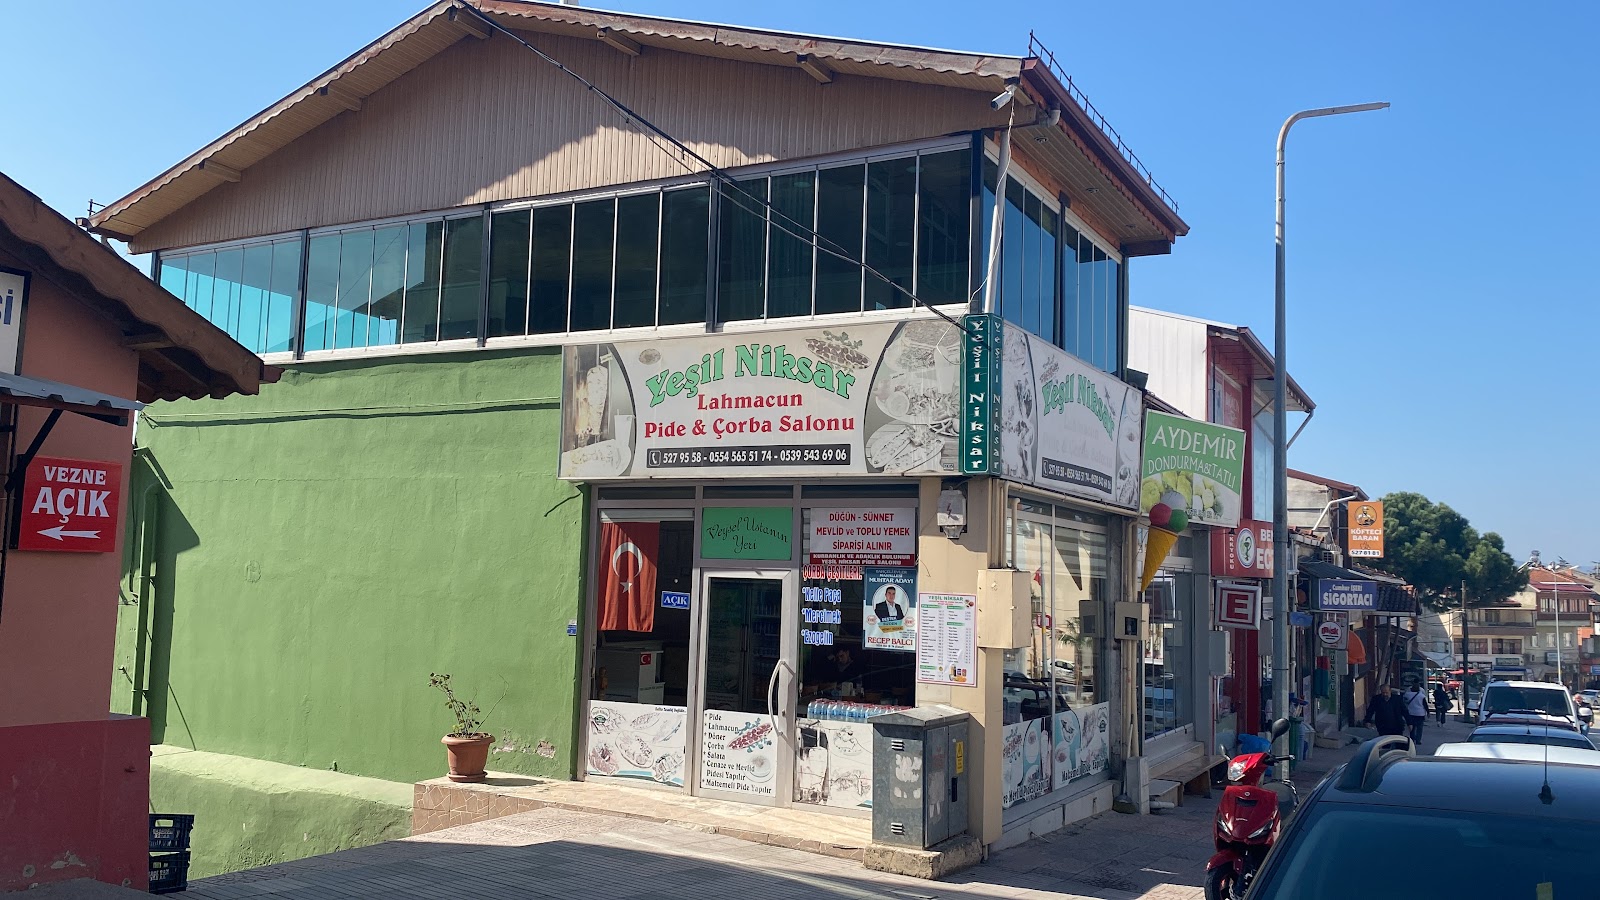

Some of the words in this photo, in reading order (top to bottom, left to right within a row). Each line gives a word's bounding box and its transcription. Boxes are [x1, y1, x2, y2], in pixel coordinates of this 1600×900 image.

[646, 348, 724, 408] Yeşil
[735, 344, 855, 399] Niksar
[697, 393, 802, 410] Lahmacun
[1042, 373, 1074, 416] Yeşil
[1077, 374, 1114, 441] Niksar
[644, 422, 686, 438] Pide
[692, 419, 707, 436] &
[713, 417, 772, 440] Çorba
[779, 415, 855, 432] Salonu
[969, 392, 984, 468] Niksar
[1152, 424, 1237, 460] AYDEMİR
[663, 453, 678, 464] 527
[680, 452, 690, 464] 95
[692, 452, 702, 463] 58
[710, 452, 730, 462] 0554
[732, 450, 747, 462] 565
[749, 450, 758, 462] 51
[761, 450, 772, 461] 74
[780, 449, 801, 461] 0539
[803, 449, 820, 460] 543
[822, 449, 834, 460] 69
[835, 449, 847, 460] 06
[44, 466, 107, 485] VEZNE
[32, 486, 111, 523] AÇIK
[830, 511, 856, 521] DÜĞÜN
[863, 511, 894, 521] SÜNNET
[707, 517, 742, 540] Veysel
[744, 516, 788, 544] Ustanın
[816, 525, 844, 536] MEVLİD
[857, 527, 881, 536] TOPLU
[884, 527, 910, 536] YEMEK
[733, 535, 757, 554] Yeri
[832, 540, 864, 551] SİPARİŞİ
[866, 542, 892, 550] ALINIR
[803, 566, 825, 581] ÇORBA
[664, 595, 688, 607] AÇIK
[824, 588, 842, 605] Paça
[1323, 589, 1372, 606] SİGORTACI
[708, 723, 738, 732] Lahmacun
[708, 742, 724, 750] Çorba
[707, 752, 725, 760] Salata
[736, 783, 750, 791] Pide
